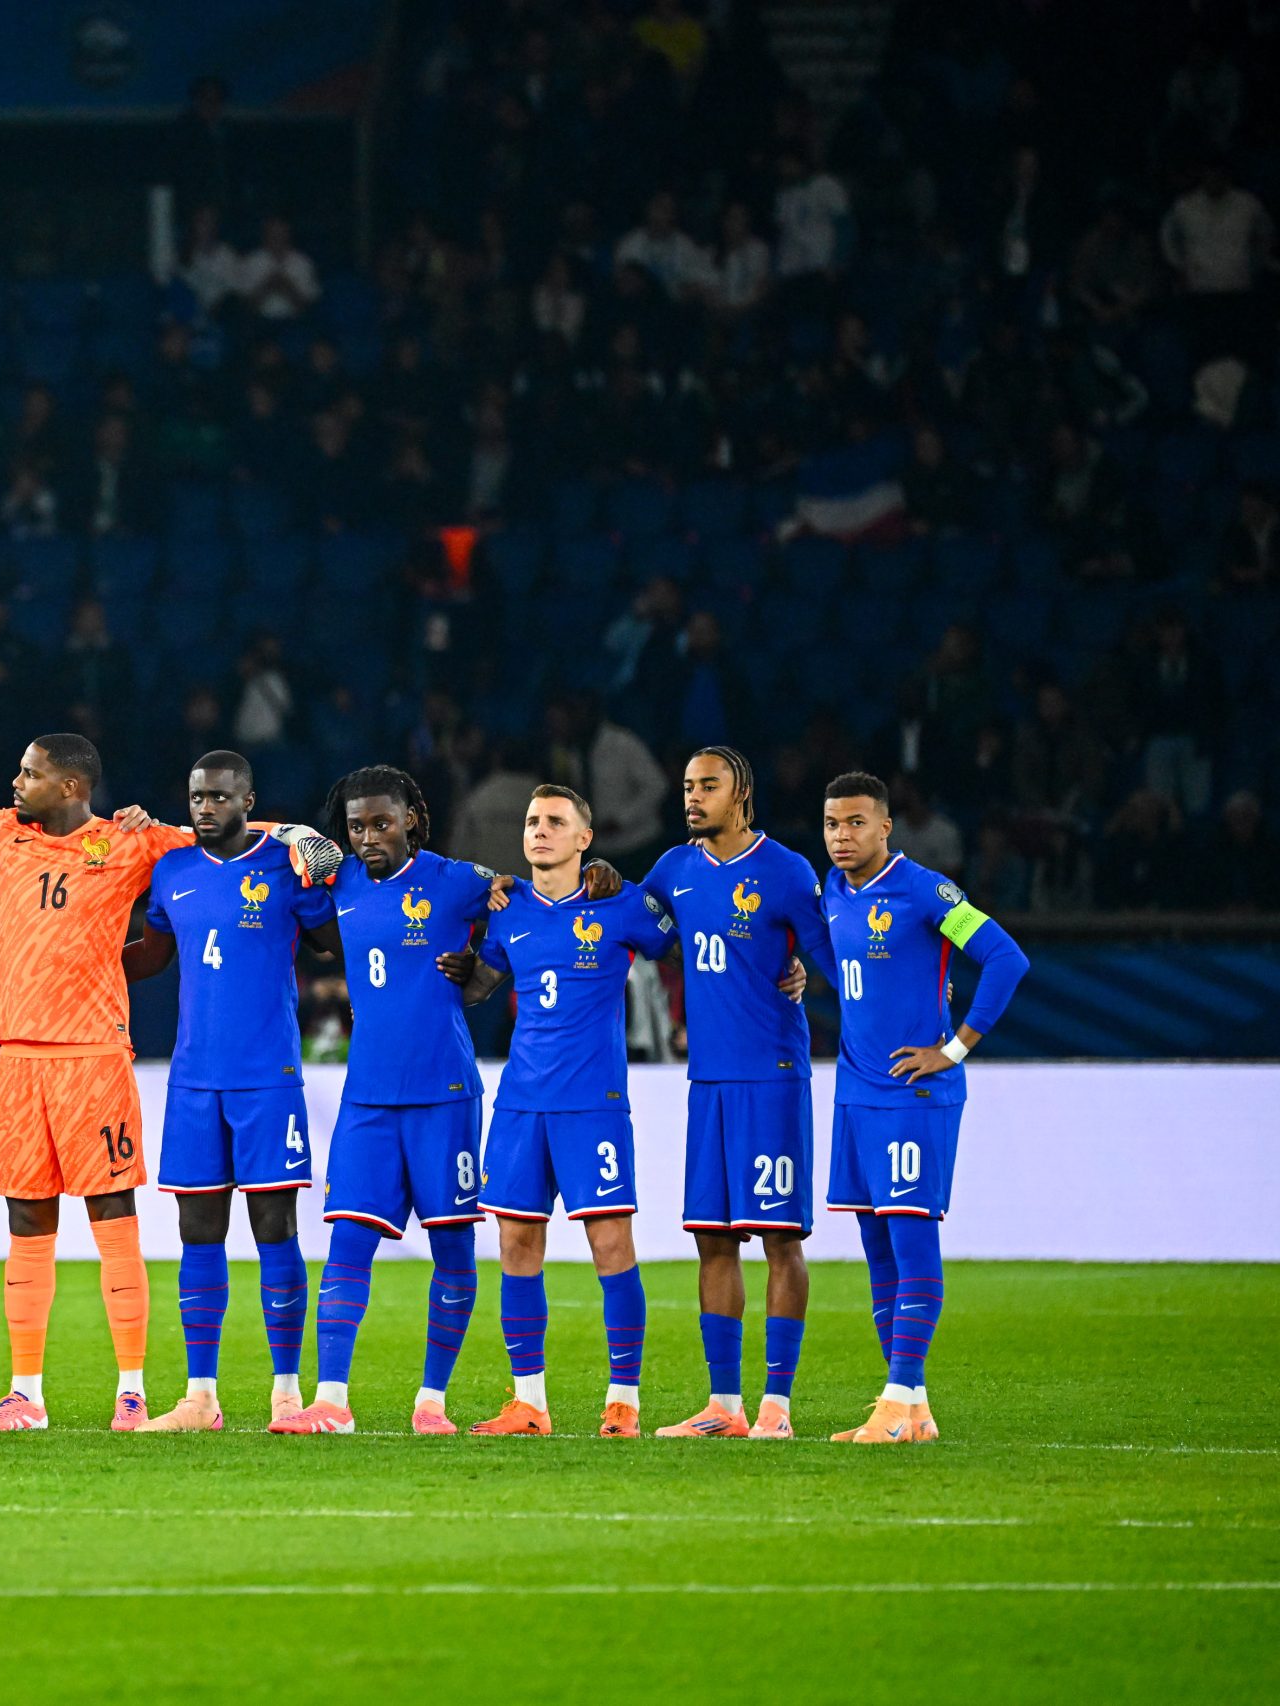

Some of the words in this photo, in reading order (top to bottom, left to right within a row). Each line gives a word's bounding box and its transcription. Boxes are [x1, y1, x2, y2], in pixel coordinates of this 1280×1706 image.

[39, 872, 69, 910] 16
[951, 912, 973, 936] RESPECT
[203, 929, 222, 969] 4
[369, 948, 386, 987] 8
[695, 932, 726, 973] 20
[540, 970, 557, 1008] 3
[841, 959, 862, 1000] 10
[100, 1122, 134, 1163] 16
[286, 1114, 304, 1153] 4
[457, 1152, 474, 1190] 8
[597, 1142, 618, 1181] 3
[754, 1155, 793, 1196] 20
[888, 1142, 920, 1182] 10
